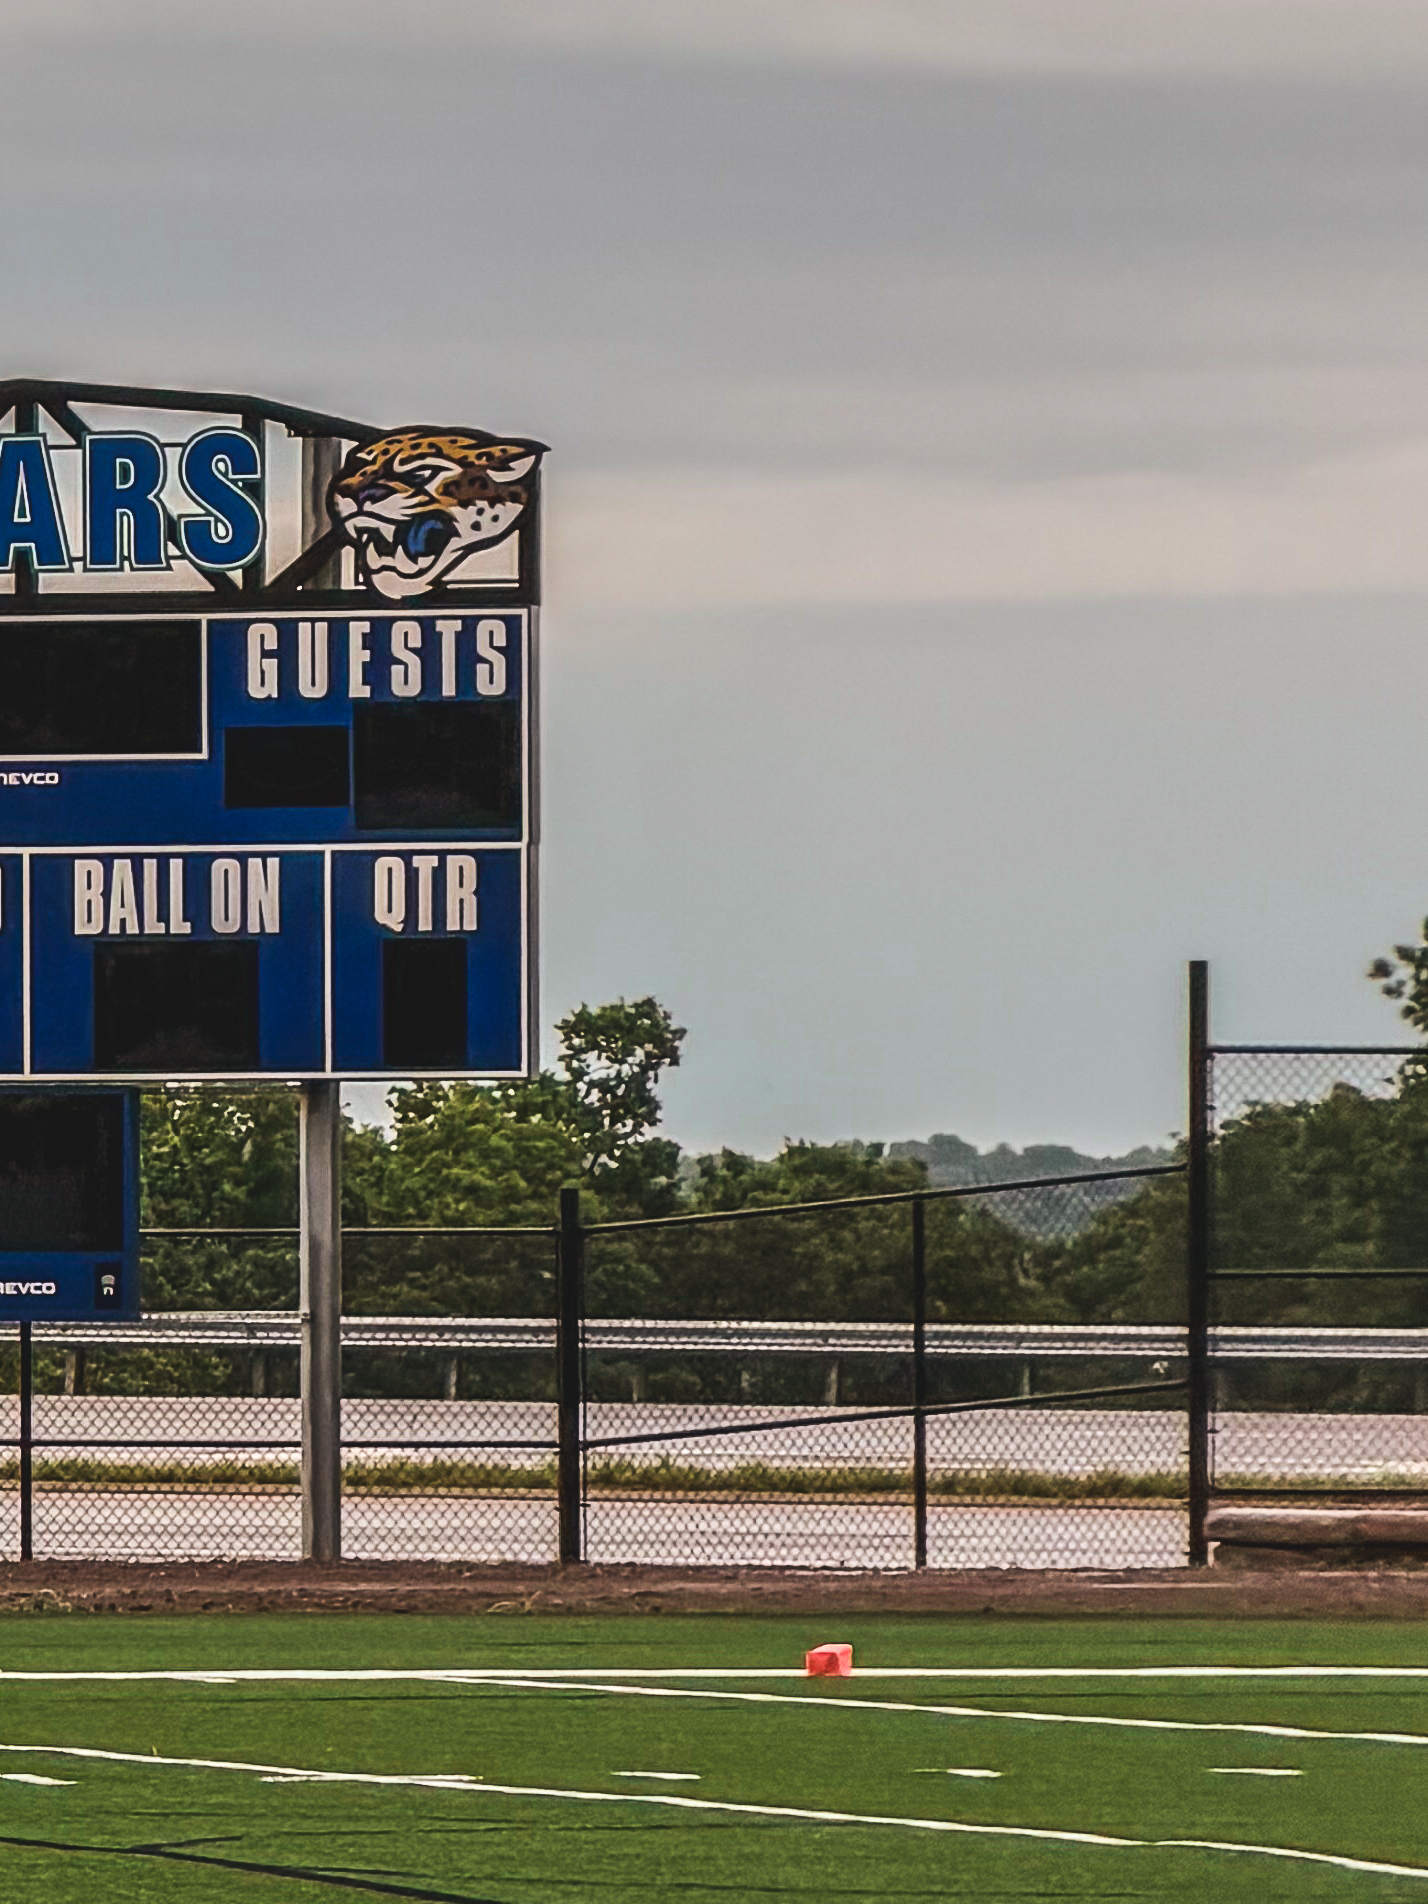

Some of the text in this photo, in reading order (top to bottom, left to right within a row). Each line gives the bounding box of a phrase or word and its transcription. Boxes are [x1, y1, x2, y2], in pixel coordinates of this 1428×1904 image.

[246, 619, 507, 699] GUESTS
[73, 857, 280, 936] BALL ON
[373, 854, 478, 933] QTR
